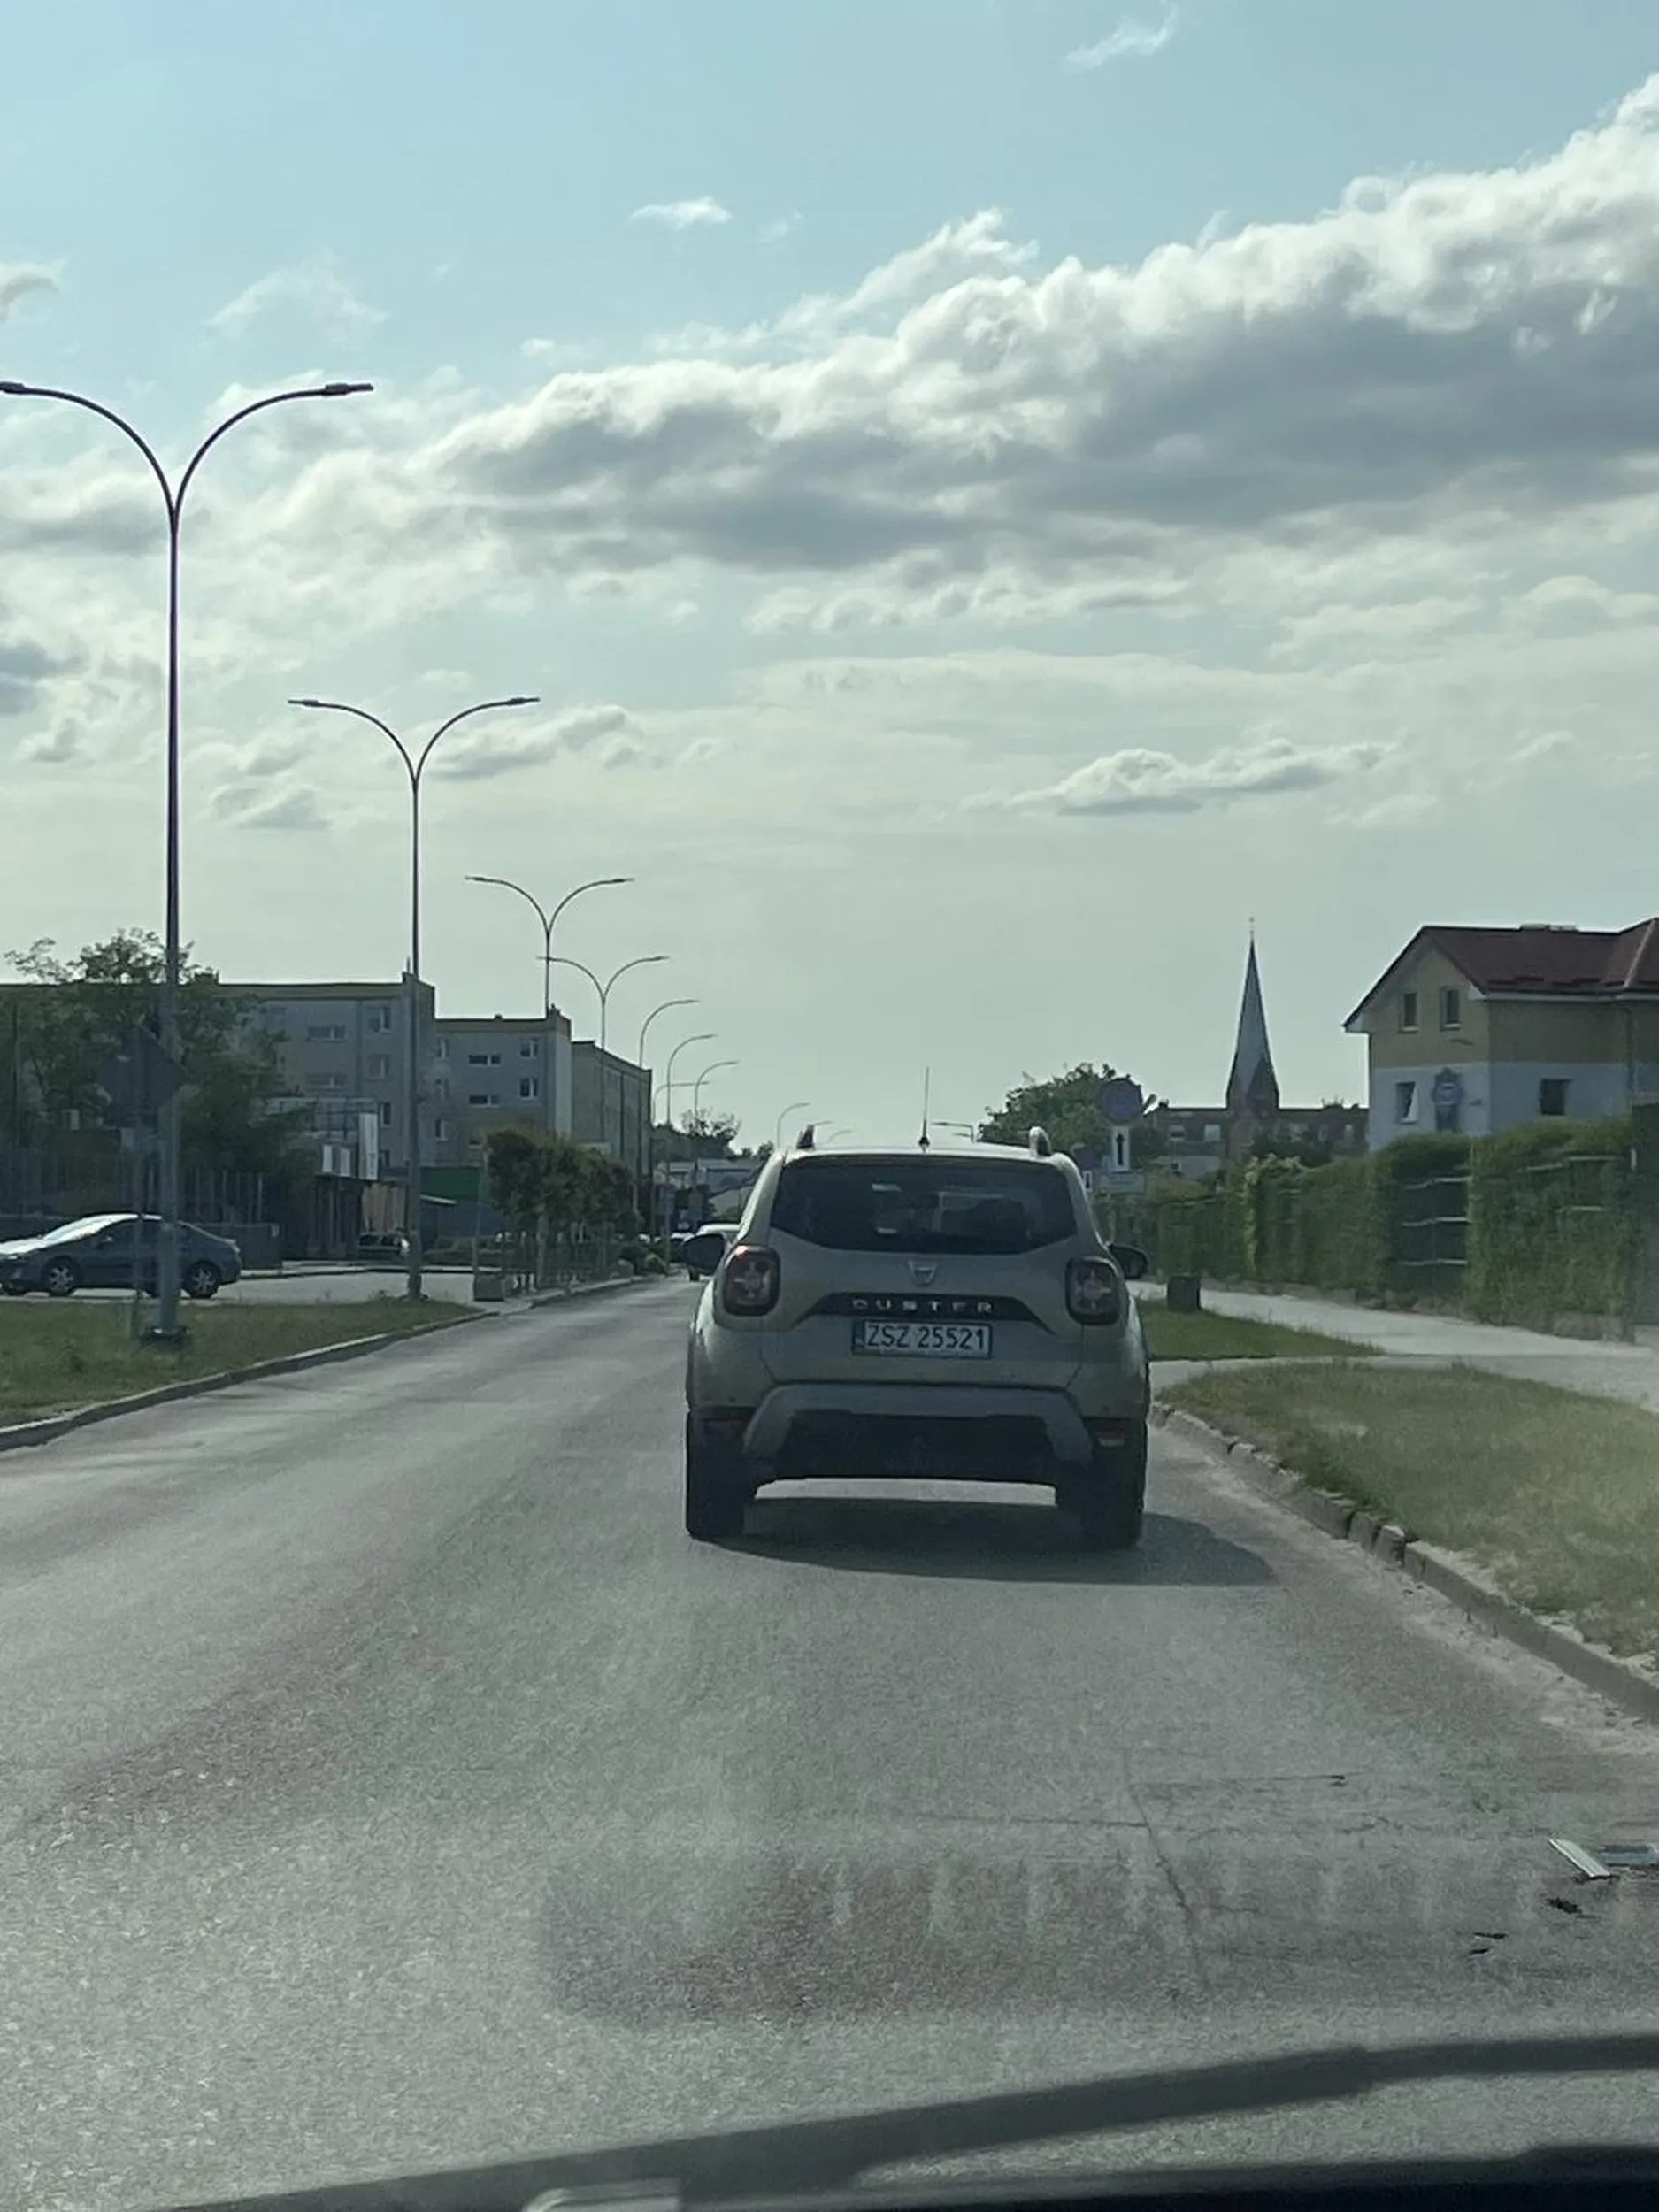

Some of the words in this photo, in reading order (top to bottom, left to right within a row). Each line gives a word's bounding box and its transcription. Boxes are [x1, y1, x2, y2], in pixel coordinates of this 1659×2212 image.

[852, 1298, 992, 1313] DUSTER
[867, 1325, 911, 1348] ZSZ
[917, 1326, 985, 1350] 25521
